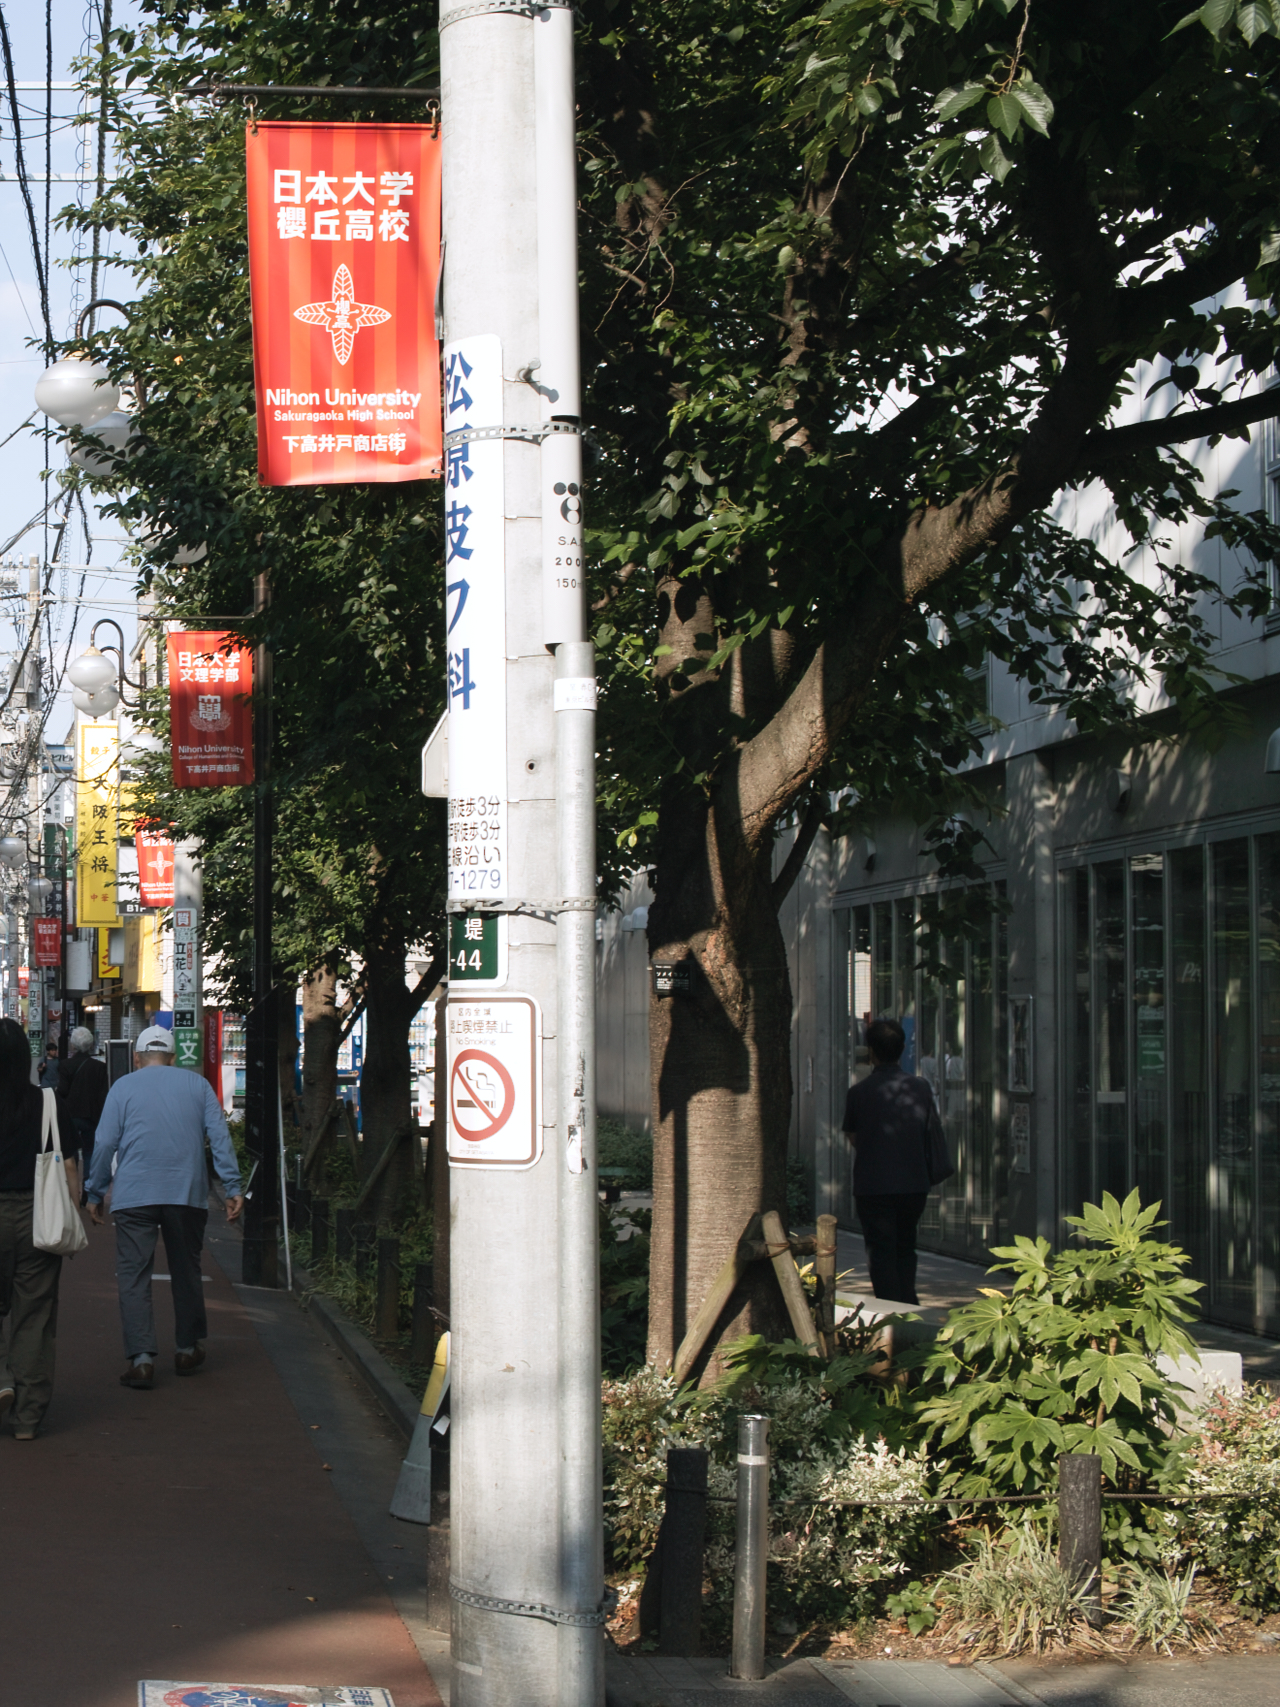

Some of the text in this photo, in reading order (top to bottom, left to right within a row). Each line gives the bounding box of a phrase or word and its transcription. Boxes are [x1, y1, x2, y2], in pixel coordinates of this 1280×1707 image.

[273, 169, 414, 206] 日本大学
[276, 206, 410, 242] 櫻丘高校
[266, 387, 422, 408] Nihon University
[274, 408, 415, 422] Sakuragaoka High School
[282, 433, 407, 456] 下高井戸商店街
[555, 557, 584, 567] 200
[178, 652, 240, 667] 日本大学
[180, 668, 239, 683] 文理学部
[90, 746, 110, 755] 餃子
[178, 744, 244, 754] Nihon University
[448, 795, 501, 818] 駅徒歩3分
[91, 777, 110, 873] 大阪王将
[90, 894, 109, 903] 中華
[126, 904, 146, 913] B1F
[175, 942, 187, 971] 立花
[179, 1040, 198, 1060] 文
